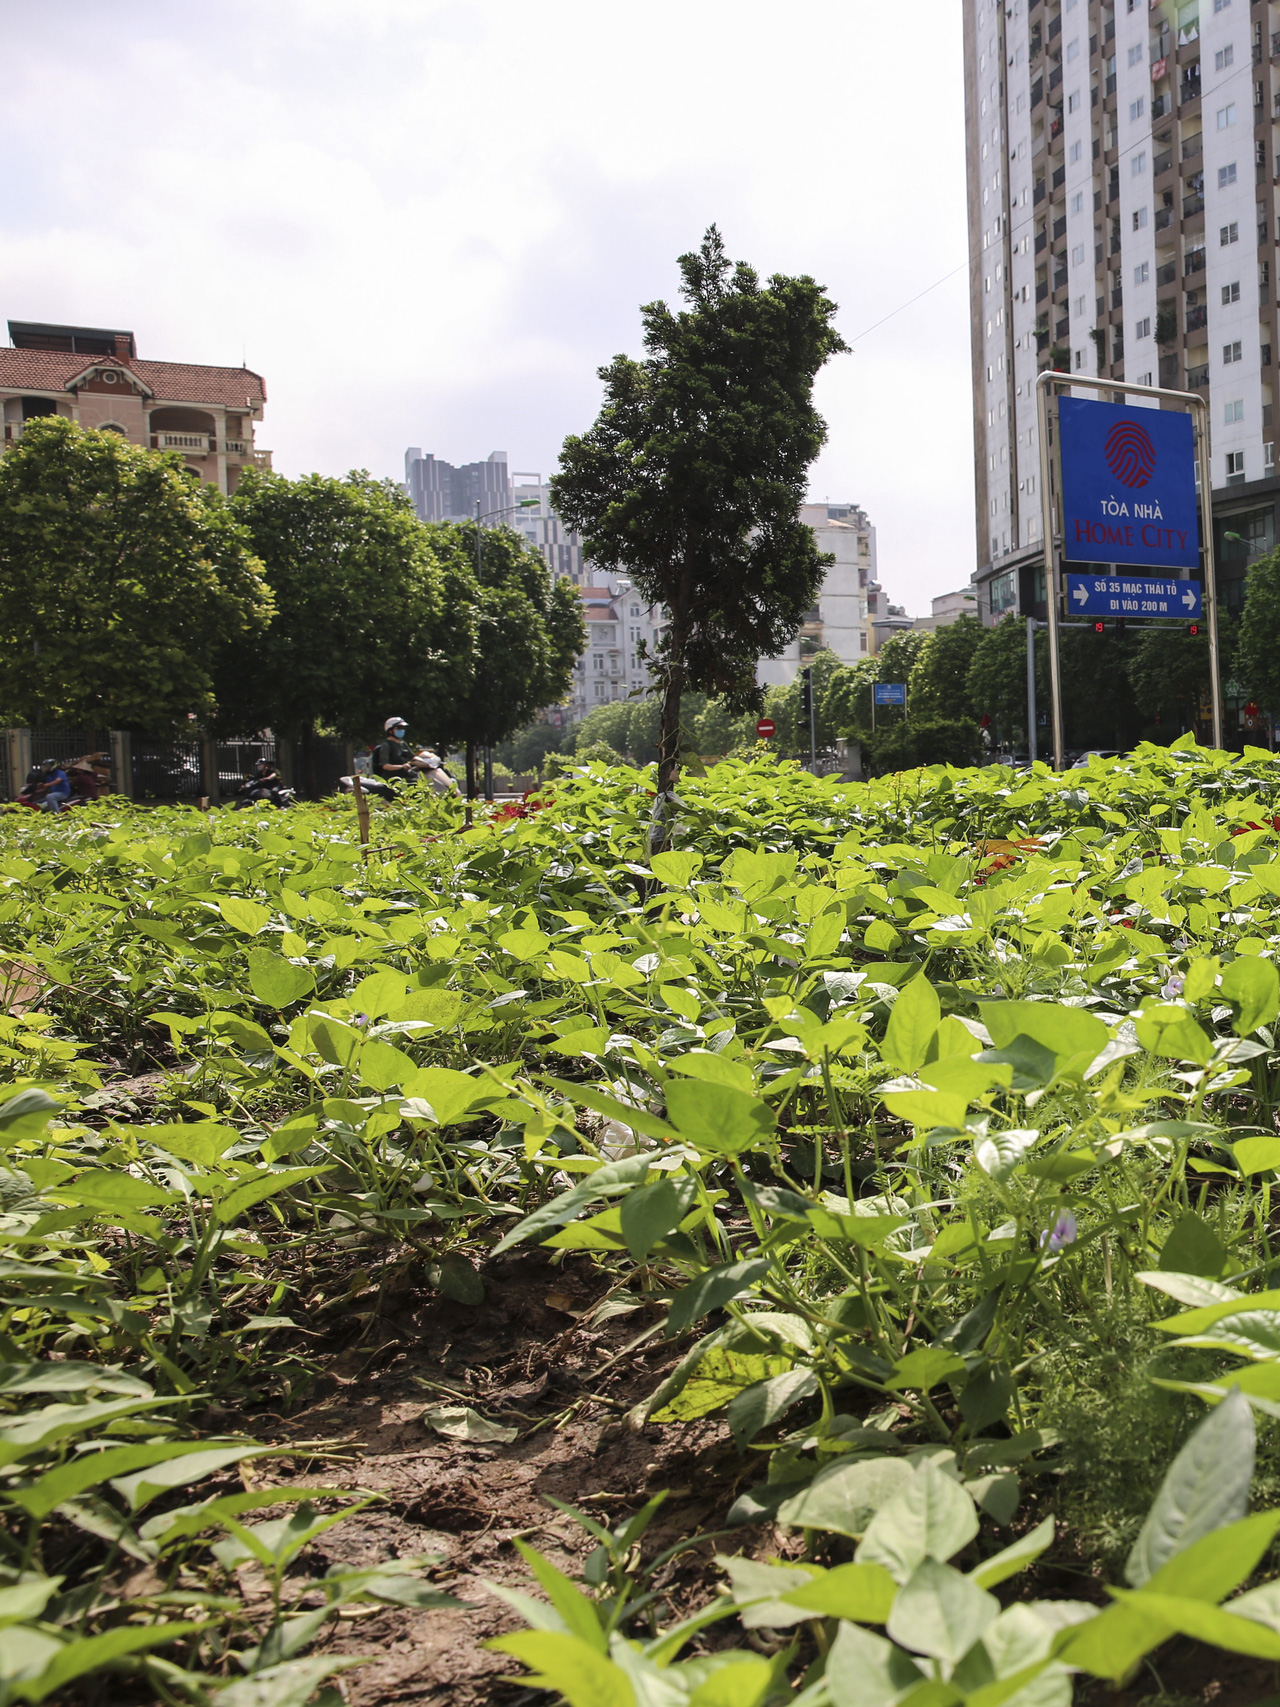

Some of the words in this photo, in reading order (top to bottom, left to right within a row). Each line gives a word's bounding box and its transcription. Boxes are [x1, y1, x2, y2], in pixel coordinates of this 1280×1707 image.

[1100, 494, 1130, 517] TÒA
[1134, 499, 1164, 521] NHÀ
[1074, 519, 1134, 546] HOME
[1141, 524, 1188, 550] CITY
[1094, 577, 1107, 592] SỐ
[1109, 582, 1120, 593] 35
[1122, 583, 1142, 596] MẠC
[1144, 582, 1164, 595] THÁI
[1166, 579, 1177, 595] TỔ
[1110, 599, 1119, 610] ĐI
[1121, 597, 1139, 611] VÀO
[1141, 600, 1158, 612] 200
[1159, 601, 1168, 612] M
[1095, 622, 1104, 632] 19
[1190, 625, 1198, 635] 19
